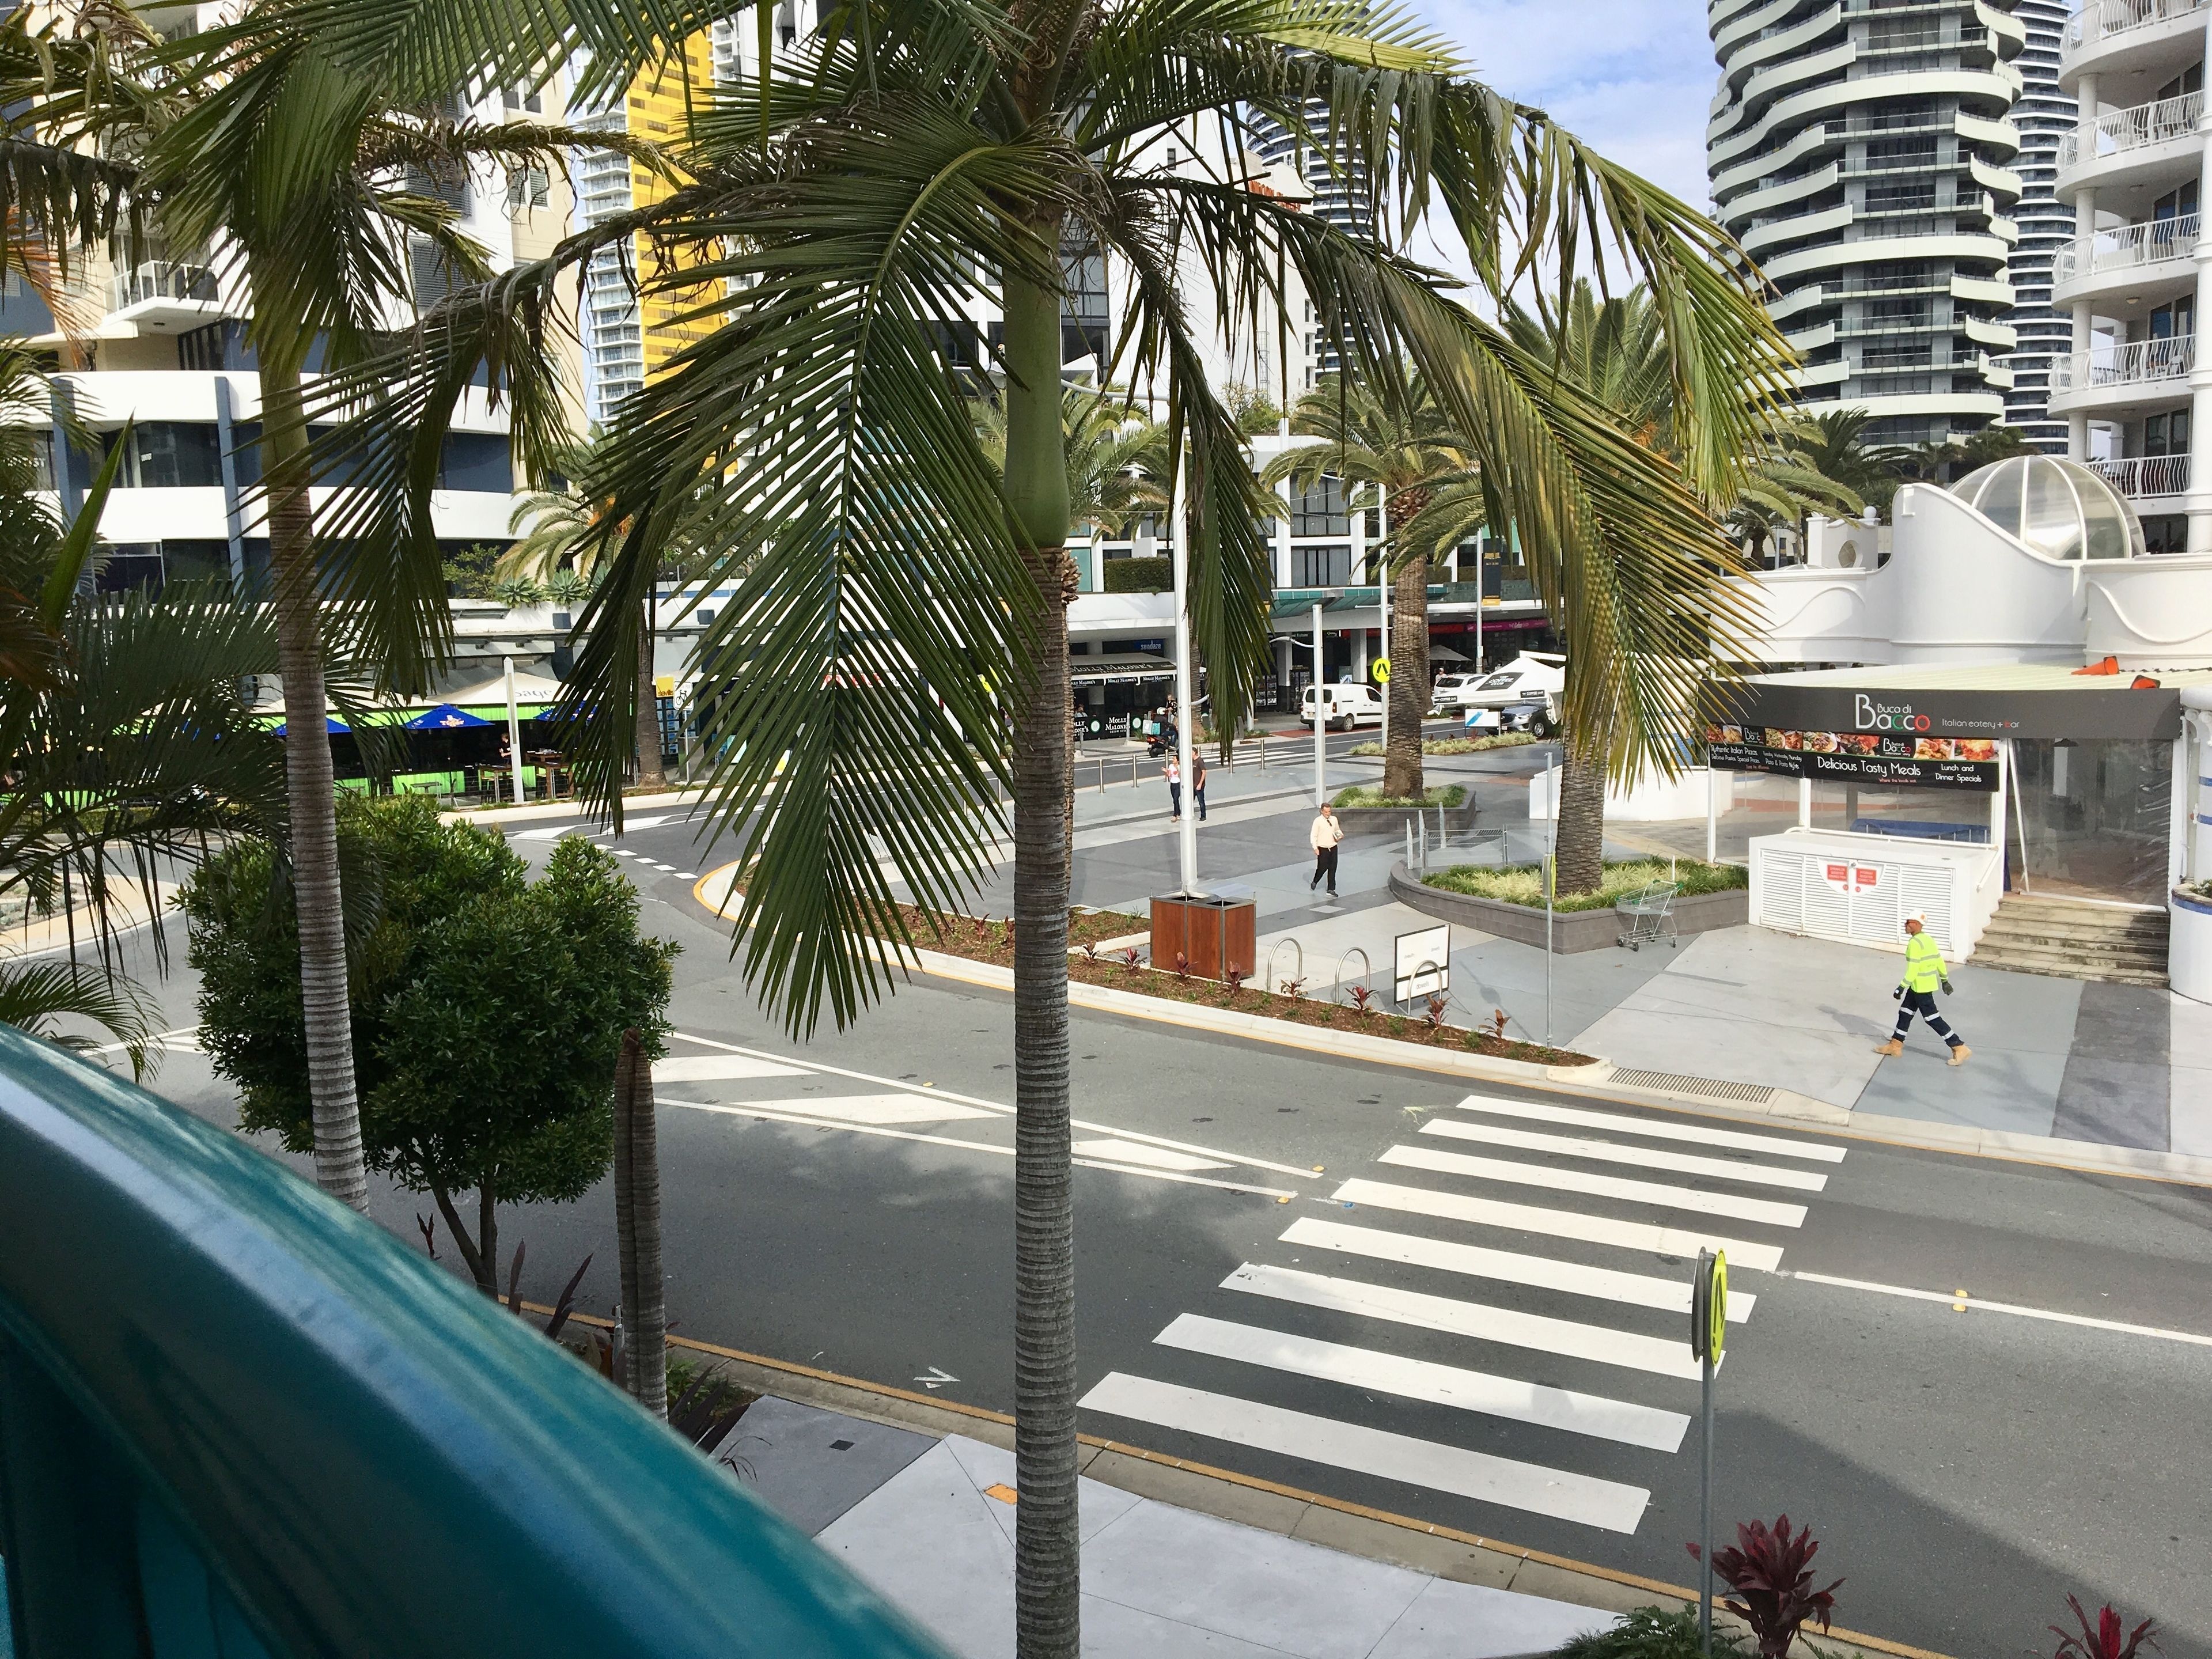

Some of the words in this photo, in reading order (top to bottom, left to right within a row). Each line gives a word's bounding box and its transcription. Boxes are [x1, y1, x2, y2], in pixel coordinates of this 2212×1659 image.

[1855, 694, 1930, 731] Bacco
[1877, 703, 1900, 713] Buca
[1903, 704, 1911, 714] di
[1942, 719, 1967, 727] Italian
[1968, 721, 1995, 730] eatery
[1883, 738, 1911, 753] Bacco
[1817, 756, 1858, 771] Delicious
[1861, 760, 1887, 778] Tasty
[1891, 763, 1922, 777] Meals
[1941, 763, 1959, 772] Lunch
[1936, 773, 1955, 781] Dinner
[1957, 774, 1982, 783] Specials
